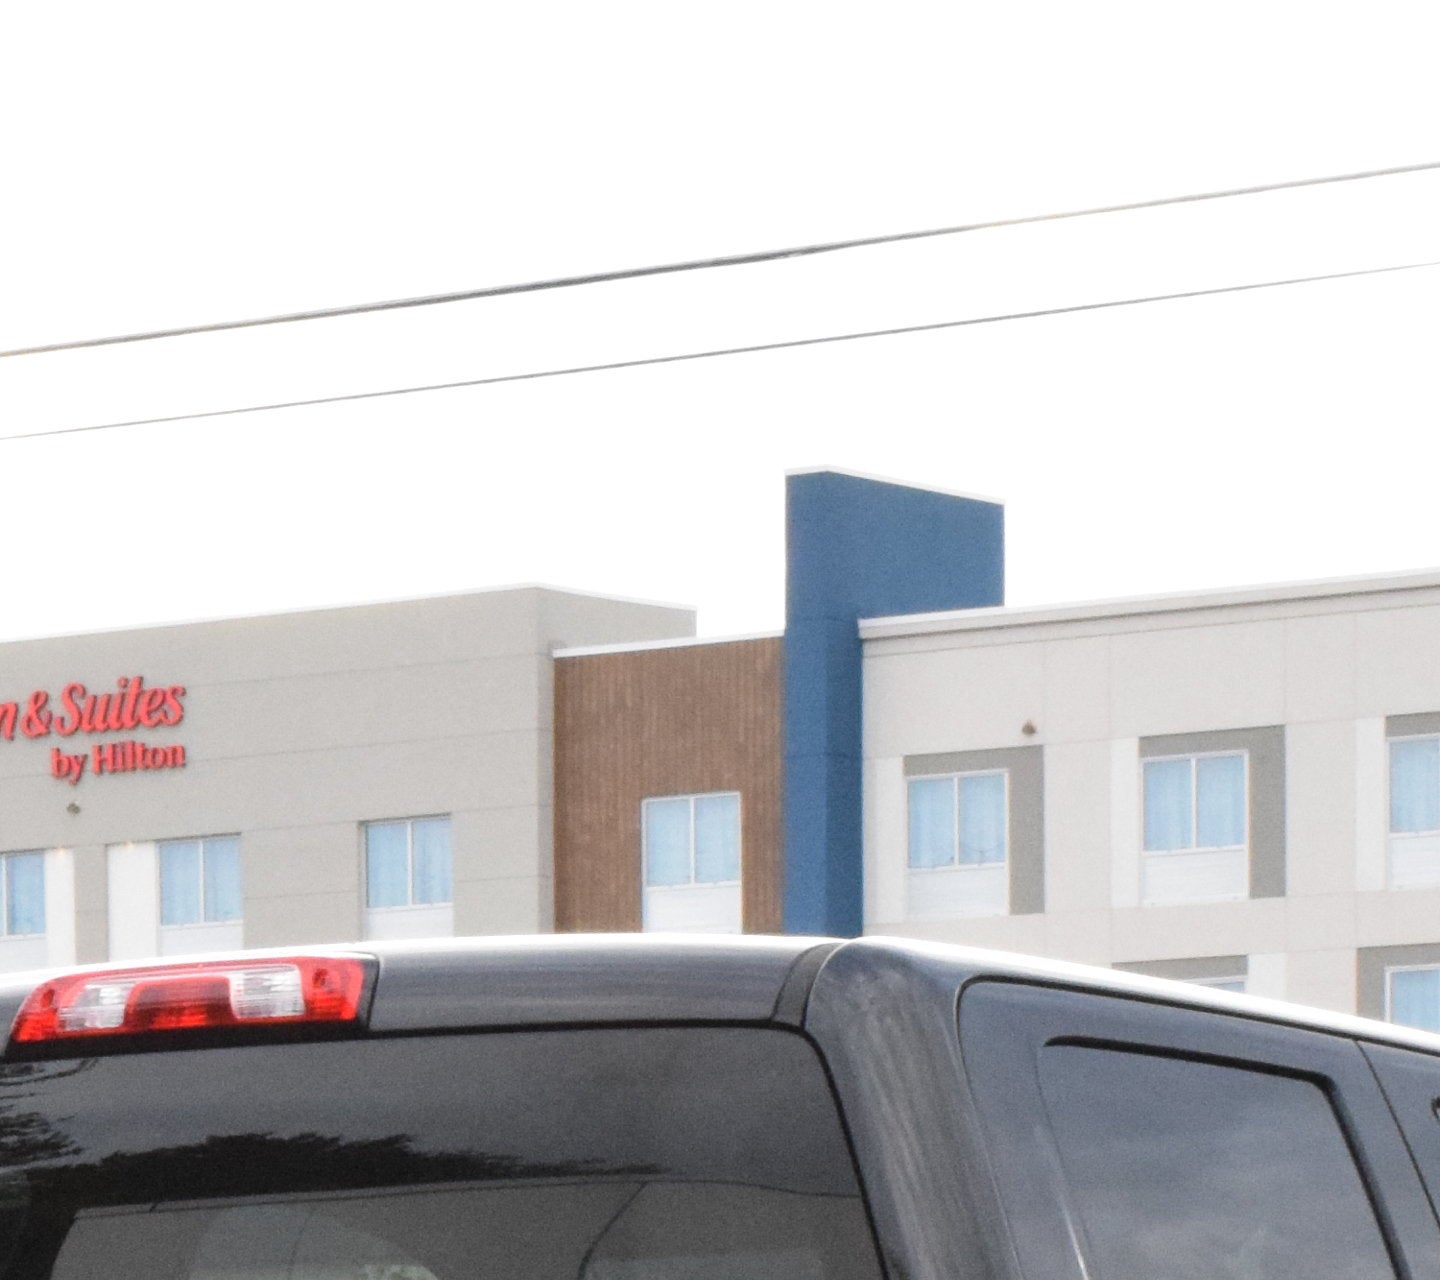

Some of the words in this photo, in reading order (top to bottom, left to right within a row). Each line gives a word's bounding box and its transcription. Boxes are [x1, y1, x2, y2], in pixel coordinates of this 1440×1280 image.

[55, 676, 186, 737] Suites
[50, 746, 86, 785] by
[92, 740, 186, 775] Hilton
